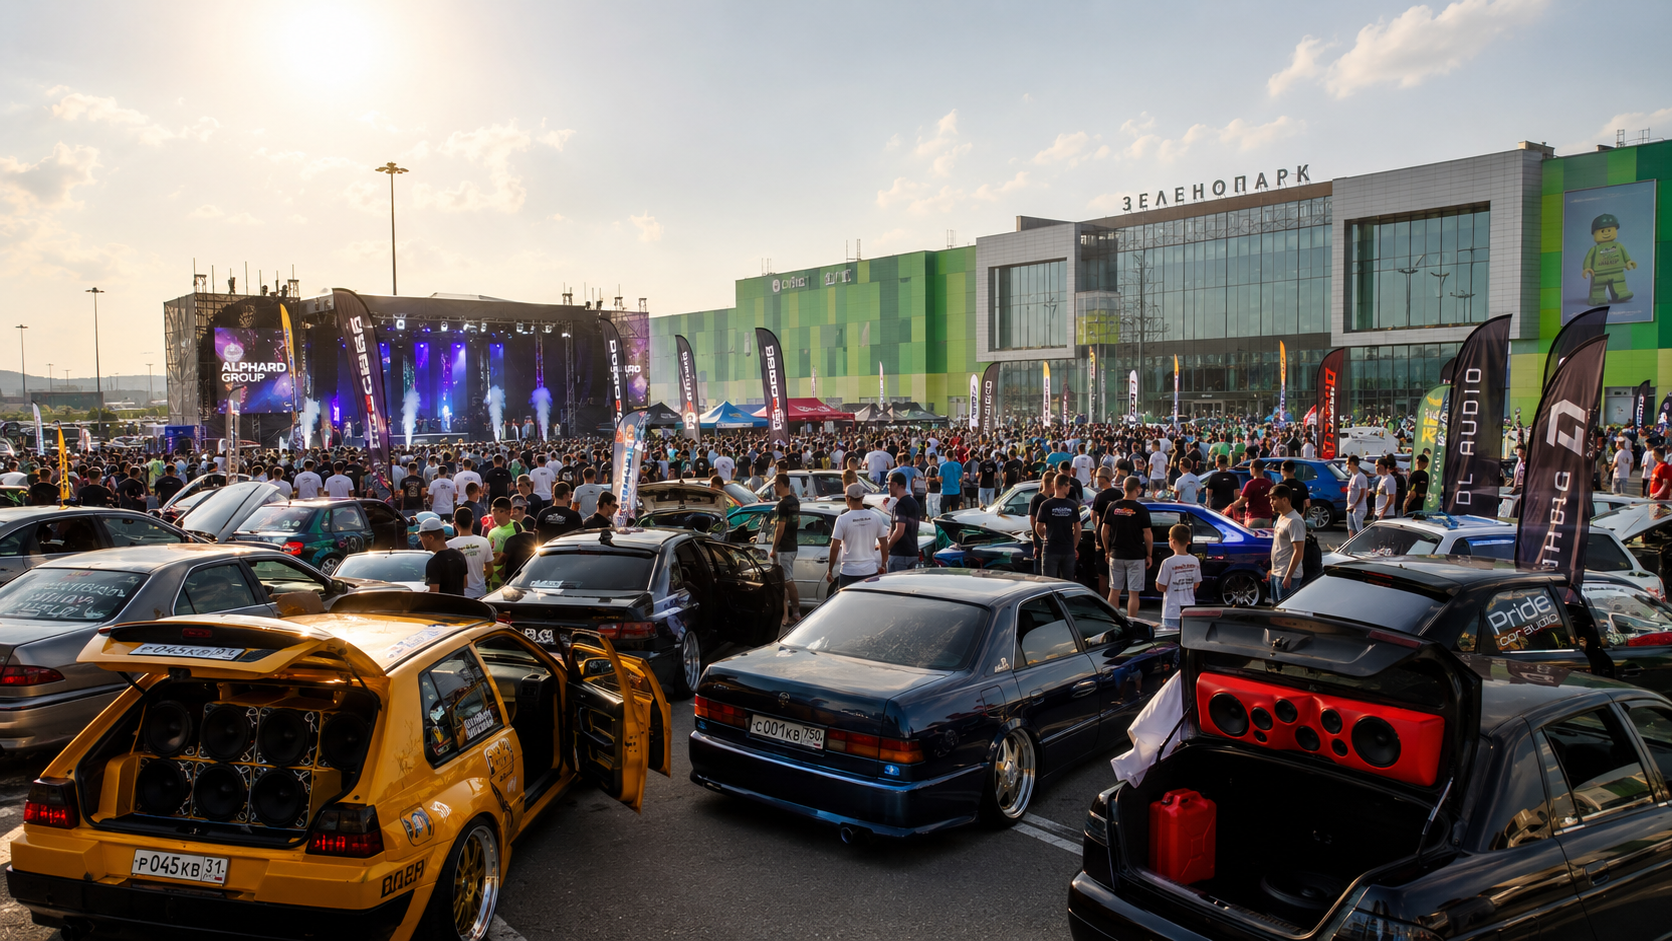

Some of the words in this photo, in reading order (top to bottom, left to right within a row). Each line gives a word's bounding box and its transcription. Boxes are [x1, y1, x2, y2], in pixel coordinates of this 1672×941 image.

[1122, 164, 1309, 211] ЗЕЛЕНОПАРК
[221, 361, 287, 372] ALPHARD
[221, 373, 265, 382] GROUP
[1460, 368, 1482, 456] AUDIO
[1456, 473, 1473, 505] DL
[1488, 595, 1551, 635] Pride
[205, 859, 222, 874] 31
